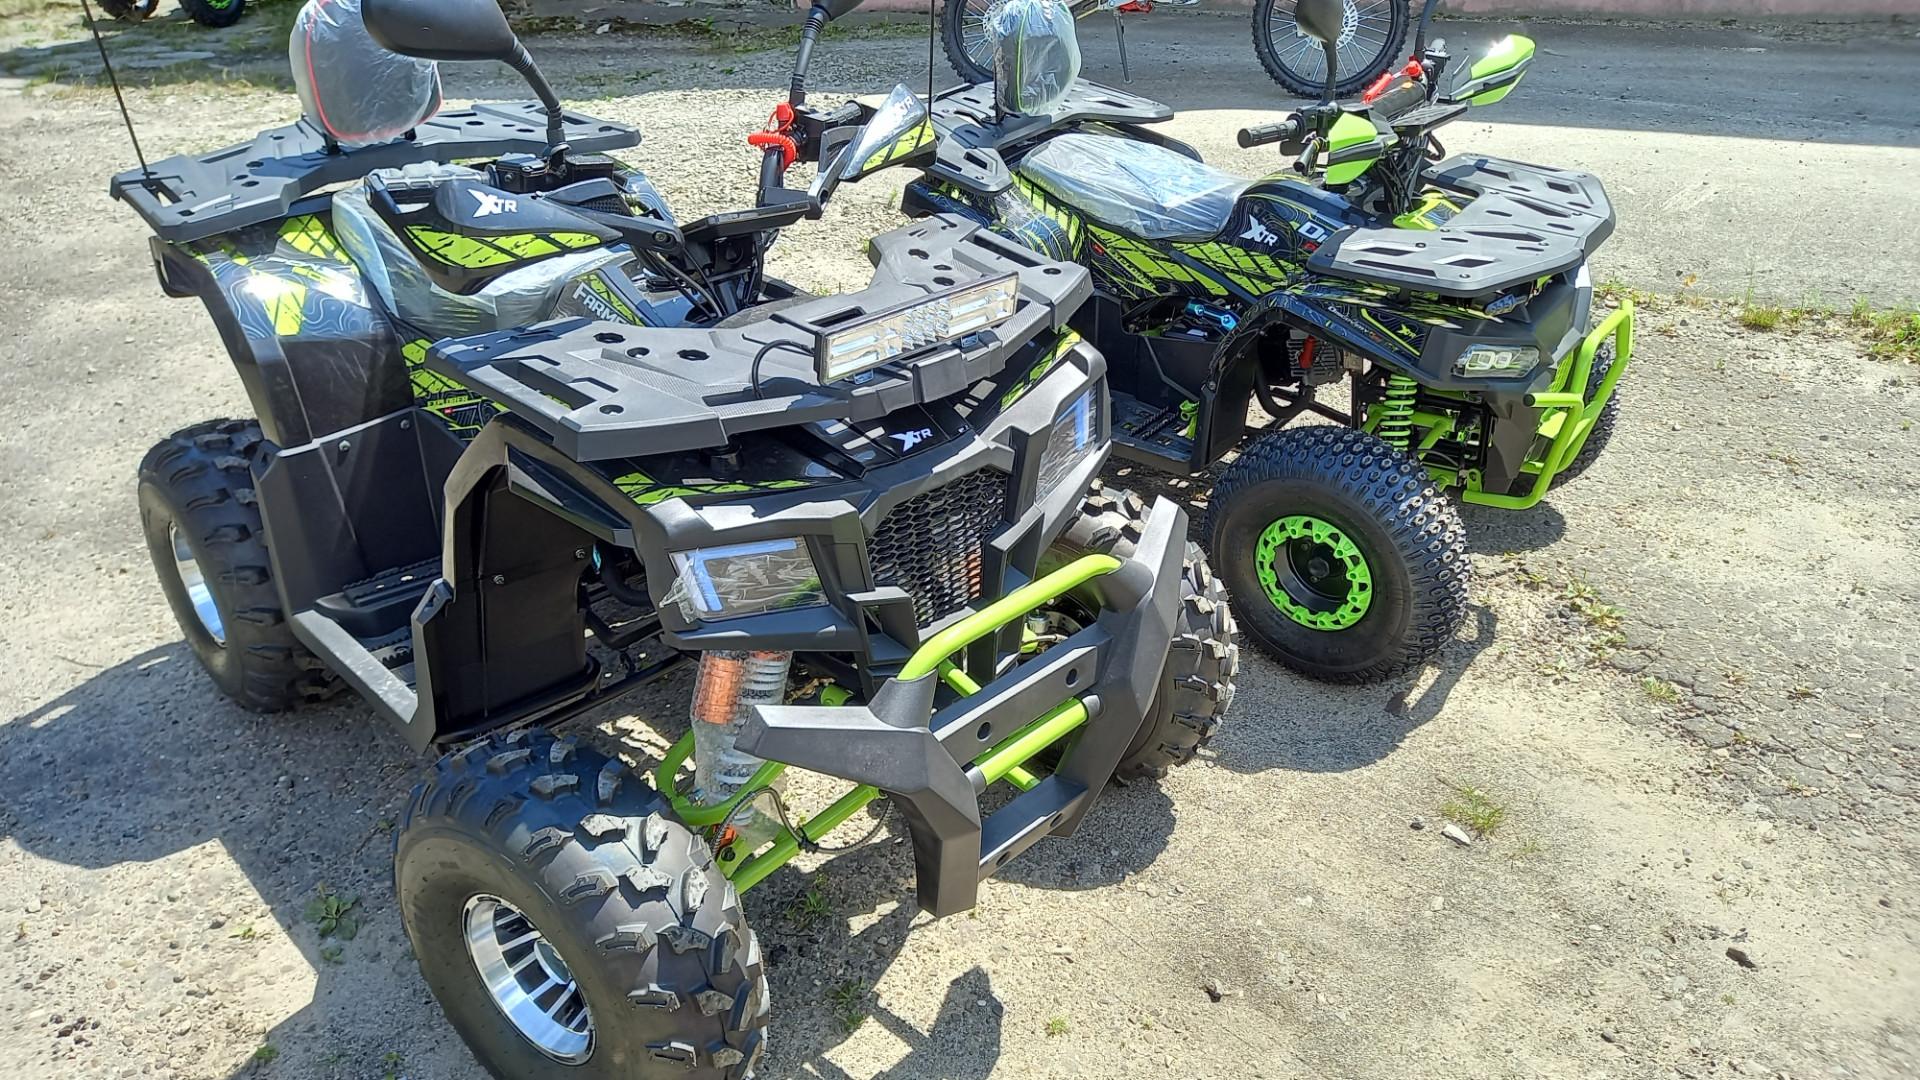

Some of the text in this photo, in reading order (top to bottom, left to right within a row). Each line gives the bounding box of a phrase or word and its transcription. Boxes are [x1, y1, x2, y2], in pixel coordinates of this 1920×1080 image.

[466, 188, 518, 218] XTR
[1239, 214, 1278, 247] XTR
[888, 428, 933, 452] XTR
